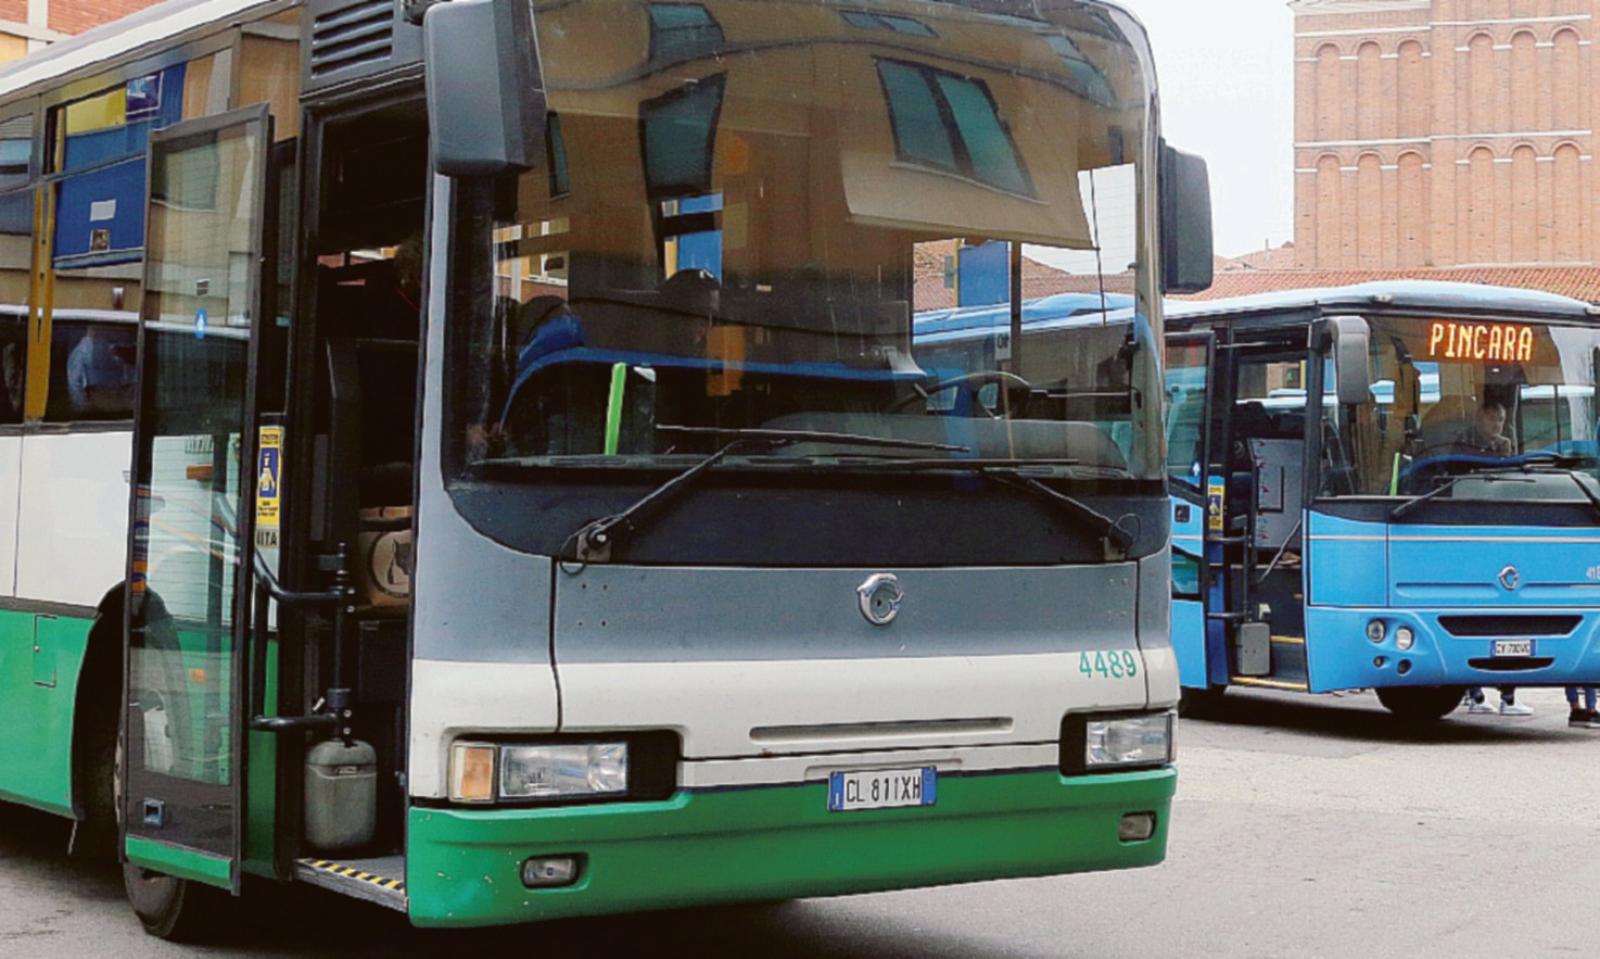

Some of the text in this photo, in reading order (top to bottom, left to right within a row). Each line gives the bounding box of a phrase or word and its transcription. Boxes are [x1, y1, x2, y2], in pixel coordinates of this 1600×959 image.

[1429, 322, 1533, 361] PINCARA
[1079, 650, 1137, 679] 4489
[846, 776, 921, 802] CL 811XH
